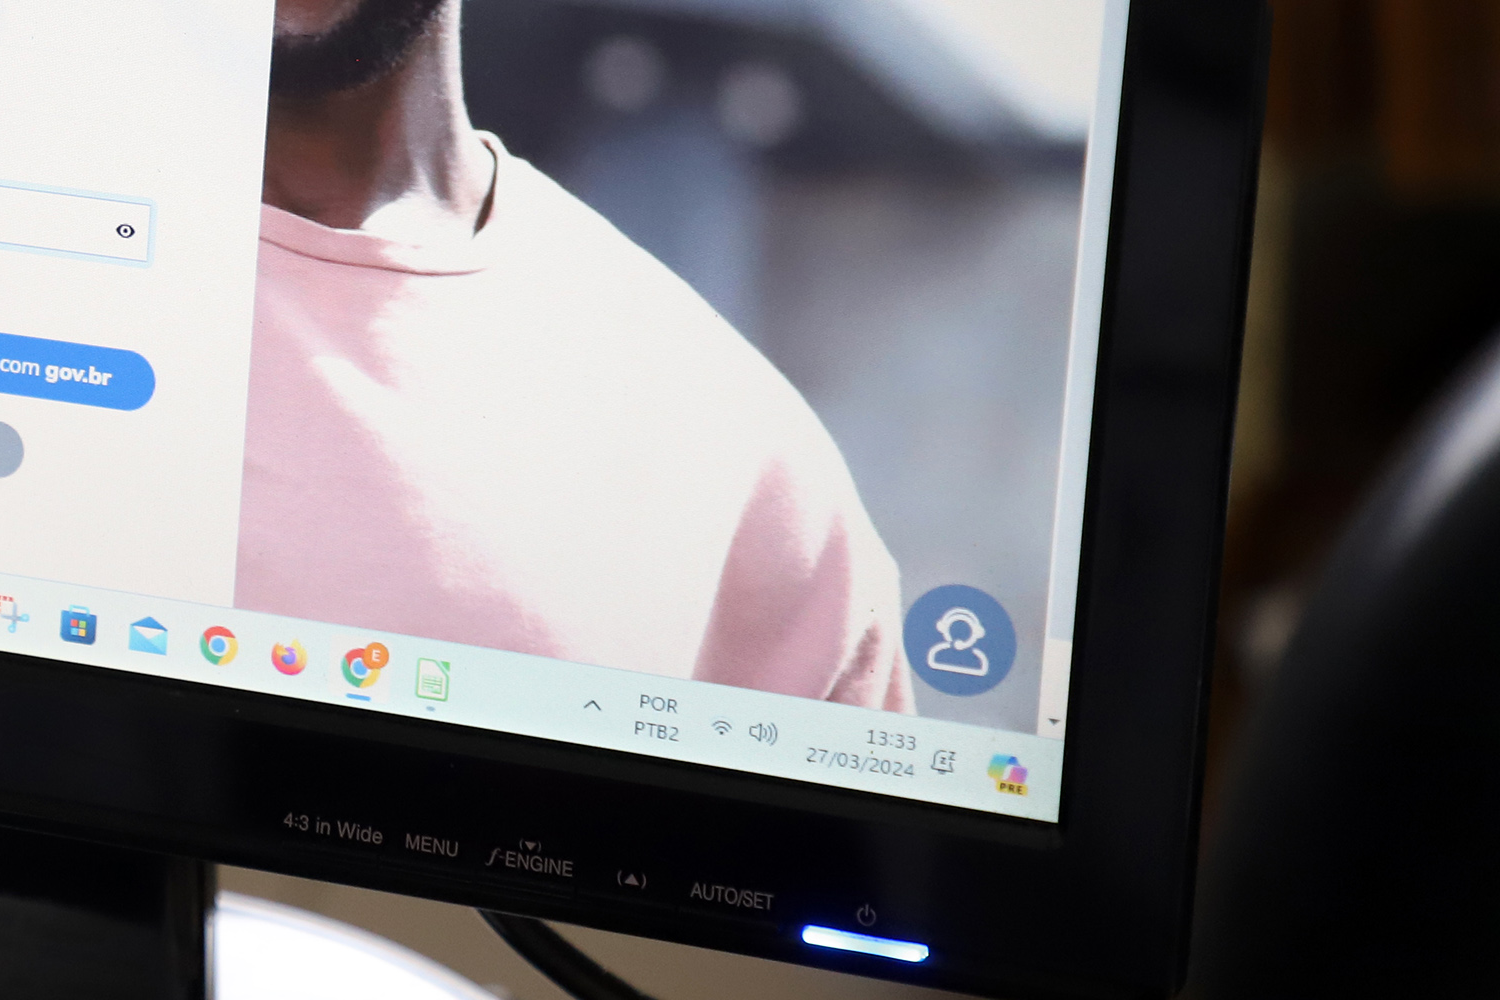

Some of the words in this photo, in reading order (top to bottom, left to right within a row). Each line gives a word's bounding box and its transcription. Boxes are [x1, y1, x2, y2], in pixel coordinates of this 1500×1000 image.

[0, 357, 41, 377] com
[44, 364, 113, 388] gov.br
[638, 693, 679, 715] POR
[633, 720, 681, 743] PTB2
[866, 728, 918, 752] 13:33
[805, 746, 917, 778] 27/03/2024
[999, 782, 1025, 796] PRE
[283, 812, 310, 832] 4:3
[315, 816, 332, 836] in
[336, 820, 384, 845] Wide
[405, 833, 459, 857] MENU
[689, 881, 775, 911] AUTO/SET
